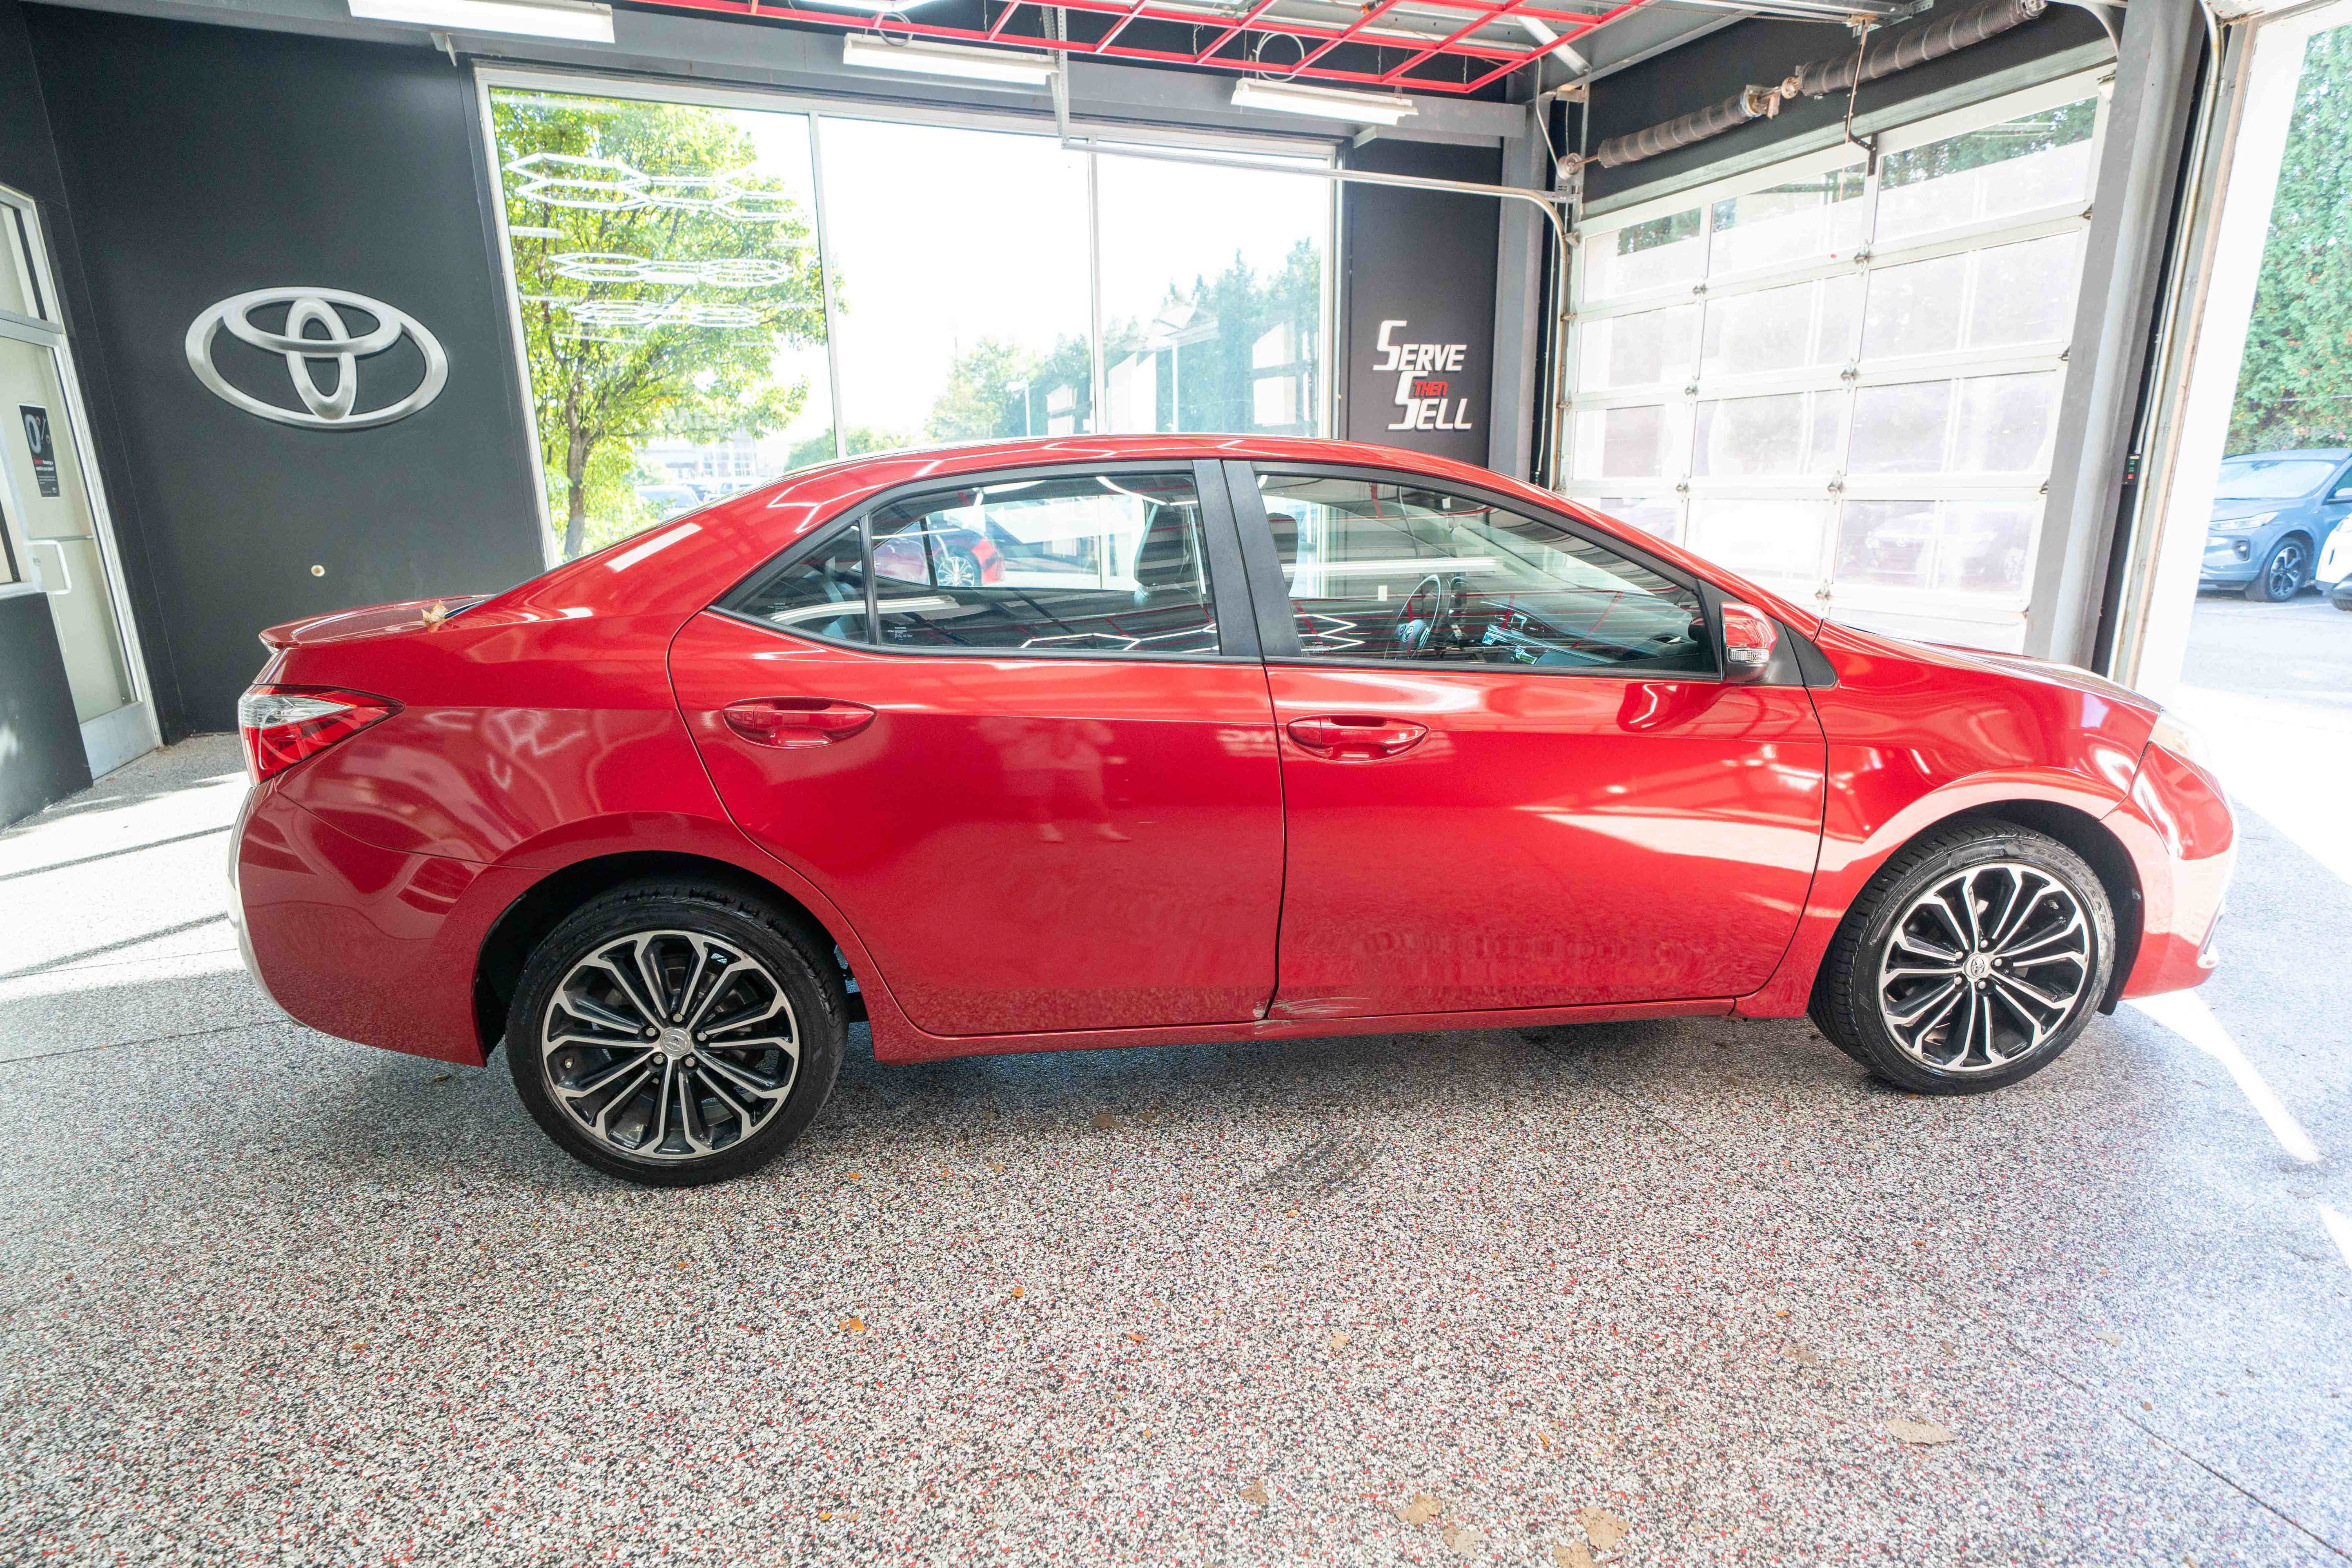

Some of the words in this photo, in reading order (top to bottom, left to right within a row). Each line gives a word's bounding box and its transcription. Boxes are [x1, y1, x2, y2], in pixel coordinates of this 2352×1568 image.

[1372, 320, 1467, 371] SERVE
[1388, 370, 1472, 430] SELL
[1414, 381, 1448, 396] THEN
[2034, 847, 2107, 924] GOODYEAR
